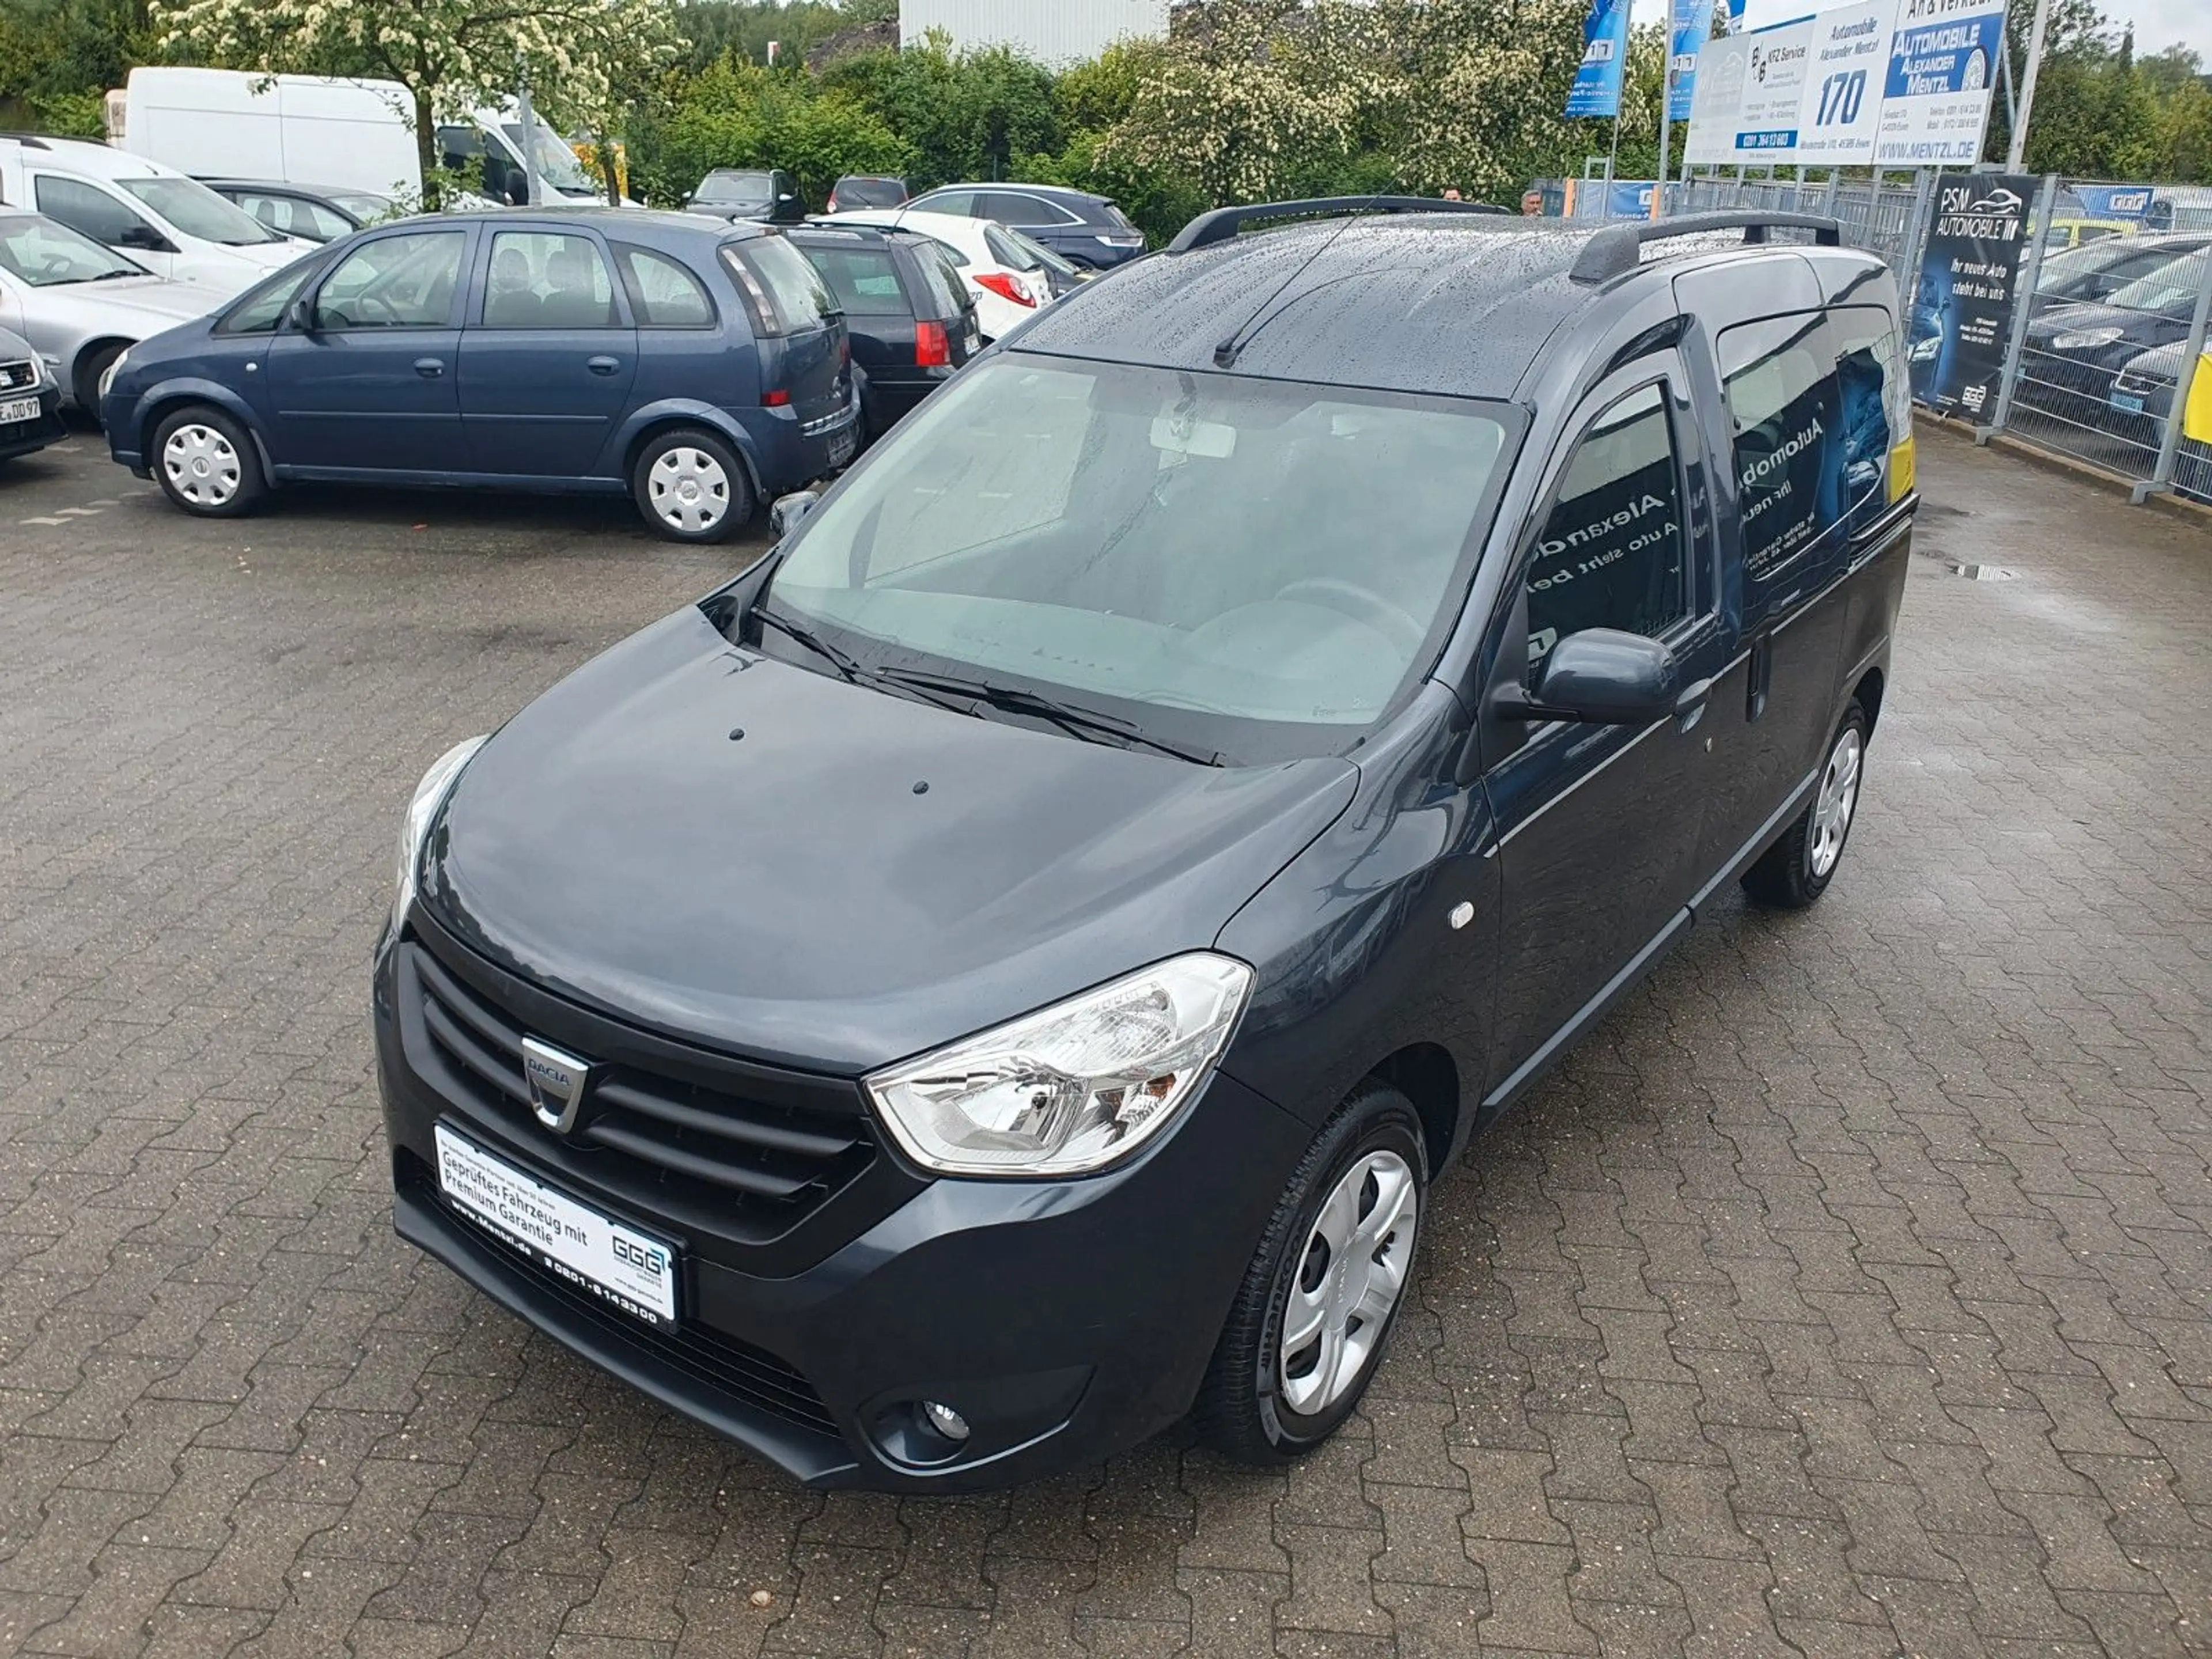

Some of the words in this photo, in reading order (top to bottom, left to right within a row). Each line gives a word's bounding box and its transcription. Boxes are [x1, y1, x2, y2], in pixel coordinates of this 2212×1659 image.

[1816, 69, 1867, 126] 170
[1906, 74, 1950, 95] MENTZL
[1940, 187, 1971, 213] PSM
[1935, 217, 2003, 240] AUTOMOBILE
[1986, 261, 2007, 279] Auto
[26, 400, 39, 416] 97
[529, 1058, 570, 1086] DACIA
[442, 1150, 500, 1196] Geprüftes
[502, 1186, 561, 1235] Fahrzeug
[564, 1224, 588, 1247] mit
[445, 1168, 497, 1213] Premium
[498, 1203, 554, 1246] Garantie
[612, 1234, 664, 1275] GGG
